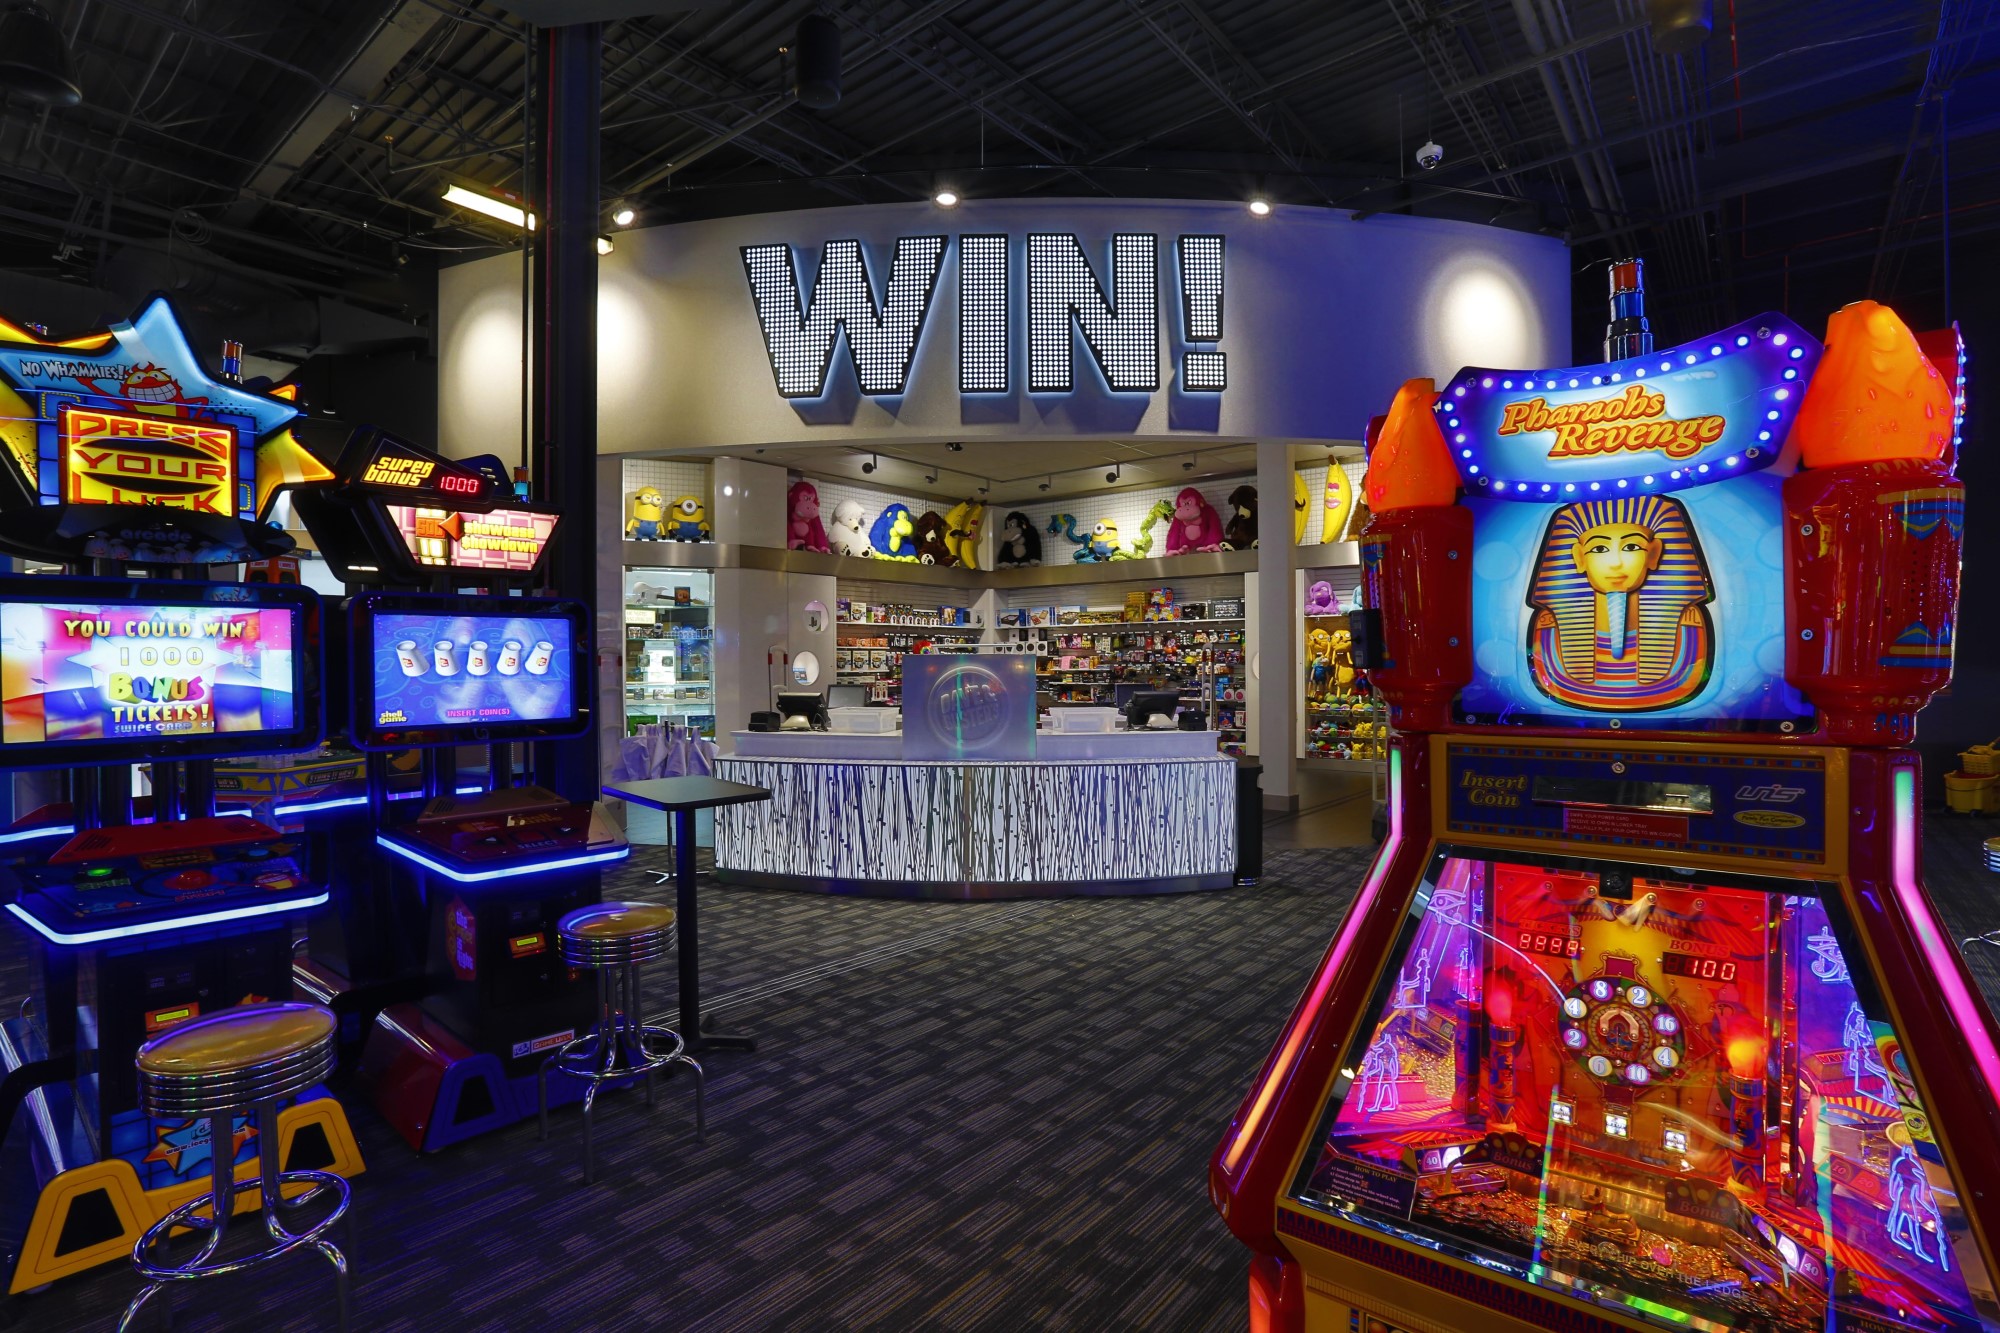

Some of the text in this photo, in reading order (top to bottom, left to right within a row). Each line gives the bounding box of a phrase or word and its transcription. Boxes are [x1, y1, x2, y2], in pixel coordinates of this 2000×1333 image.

[739, 233, 1227, 398] WIN!
[20, 359, 125, 381] NO WHAMMIES!
[1498, 384, 1666, 436] Pharaohs
[71, 415, 228, 462] PRESS
[1547, 414, 1725, 461] Revenge
[74, 449, 227, 482] YOUR
[376, 456, 436, 479] SUPER
[439, 476, 480, 494] 1000
[463, 520, 536, 539] showcase
[63, 619, 244, 639] YOU COULD WIN
[119, 646, 204, 667] 1000
[108, 671, 206, 704] BONUS
[111, 702, 210, 724] TICKETS!
[379, 716, 408, 725] game
[381, 710, 403, 718] shell
[447, 708, 510, 717] INSERT COIN(S)
[113, 723, 153, 734] SWIPE
[1461, 770, 1527, 790] Insert
[1469, 788, 1519, 807] Coin
[516, 839, 559, 849] SELECT
[1669, 939, 1730, 957] BONUS
[1692, 959, 1736, 981] 100
[1594, 980, 1609, 1000] 8
[1632, 986, 1647, 1006] 2
[1567, 998, 1581, 1016] 4
[1656, 1014, 1675, 1033] 16
[1567, 1029, 1582, 1048] 2
[1592, 1057, 1606, 1076] 6
[1657, 1047, 1673, 1067] 4
[1628, 1064, 1648, 1083] 10
[1426, 1156, 1438, 1166] 40
[1493, 1151, 1533, 1171] Bonus
[1354, 1165, 1398, 1183] HOW TO PLAY
[1678, 1200, 1729, 1223] Bonus
[1803, 1261, 1819, 1277] 40
